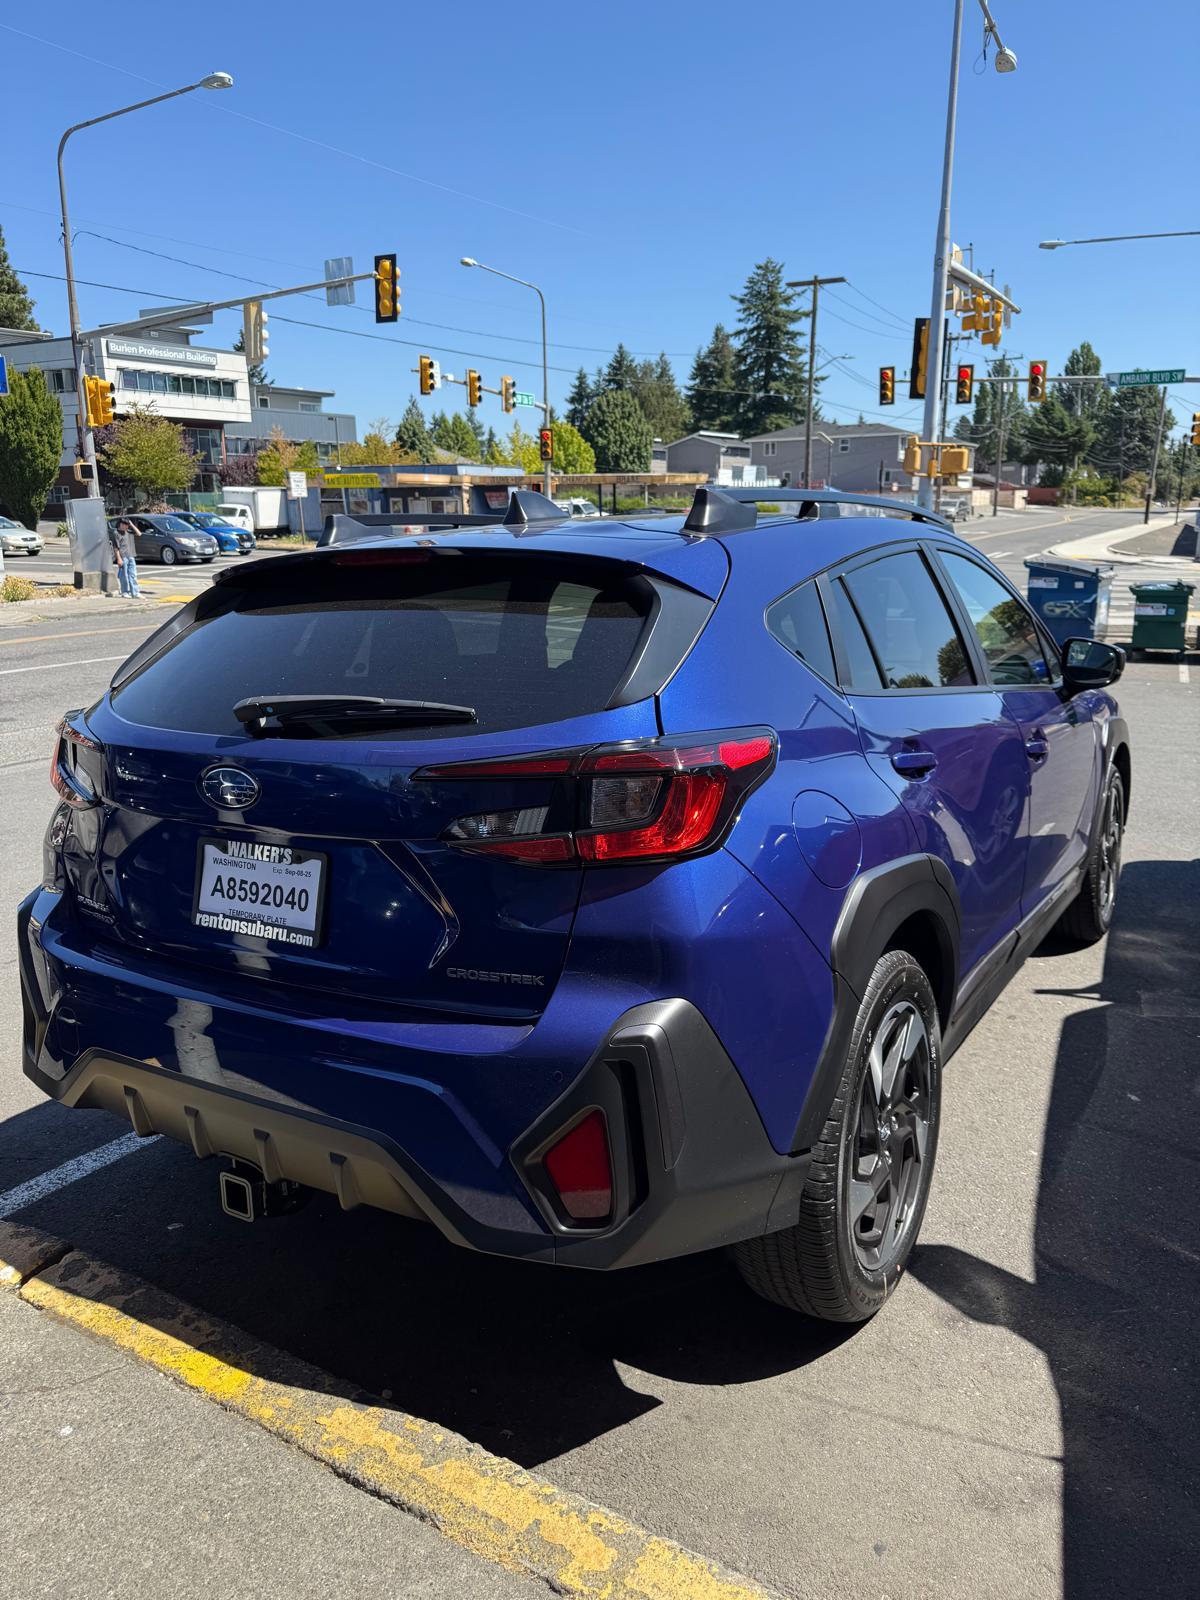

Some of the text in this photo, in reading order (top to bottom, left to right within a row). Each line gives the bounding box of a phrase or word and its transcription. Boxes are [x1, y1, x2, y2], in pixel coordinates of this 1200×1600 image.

[110, 343, 217, 364] Burien Professional Building
[1120, 371, 1183, 384] AMBAUM BLVD SW
[227, 840, 293, 865] WALKER'S
[212, 857, 256, 870] WASHINGTON
[210, 874, 309, 912] A8592040
[228, 908, 287, 925] TEMPORARY PLATE
[195, 912, 313, 947] rentonsubaru.com
[446, 967, 545, 986] CROSSTREK
